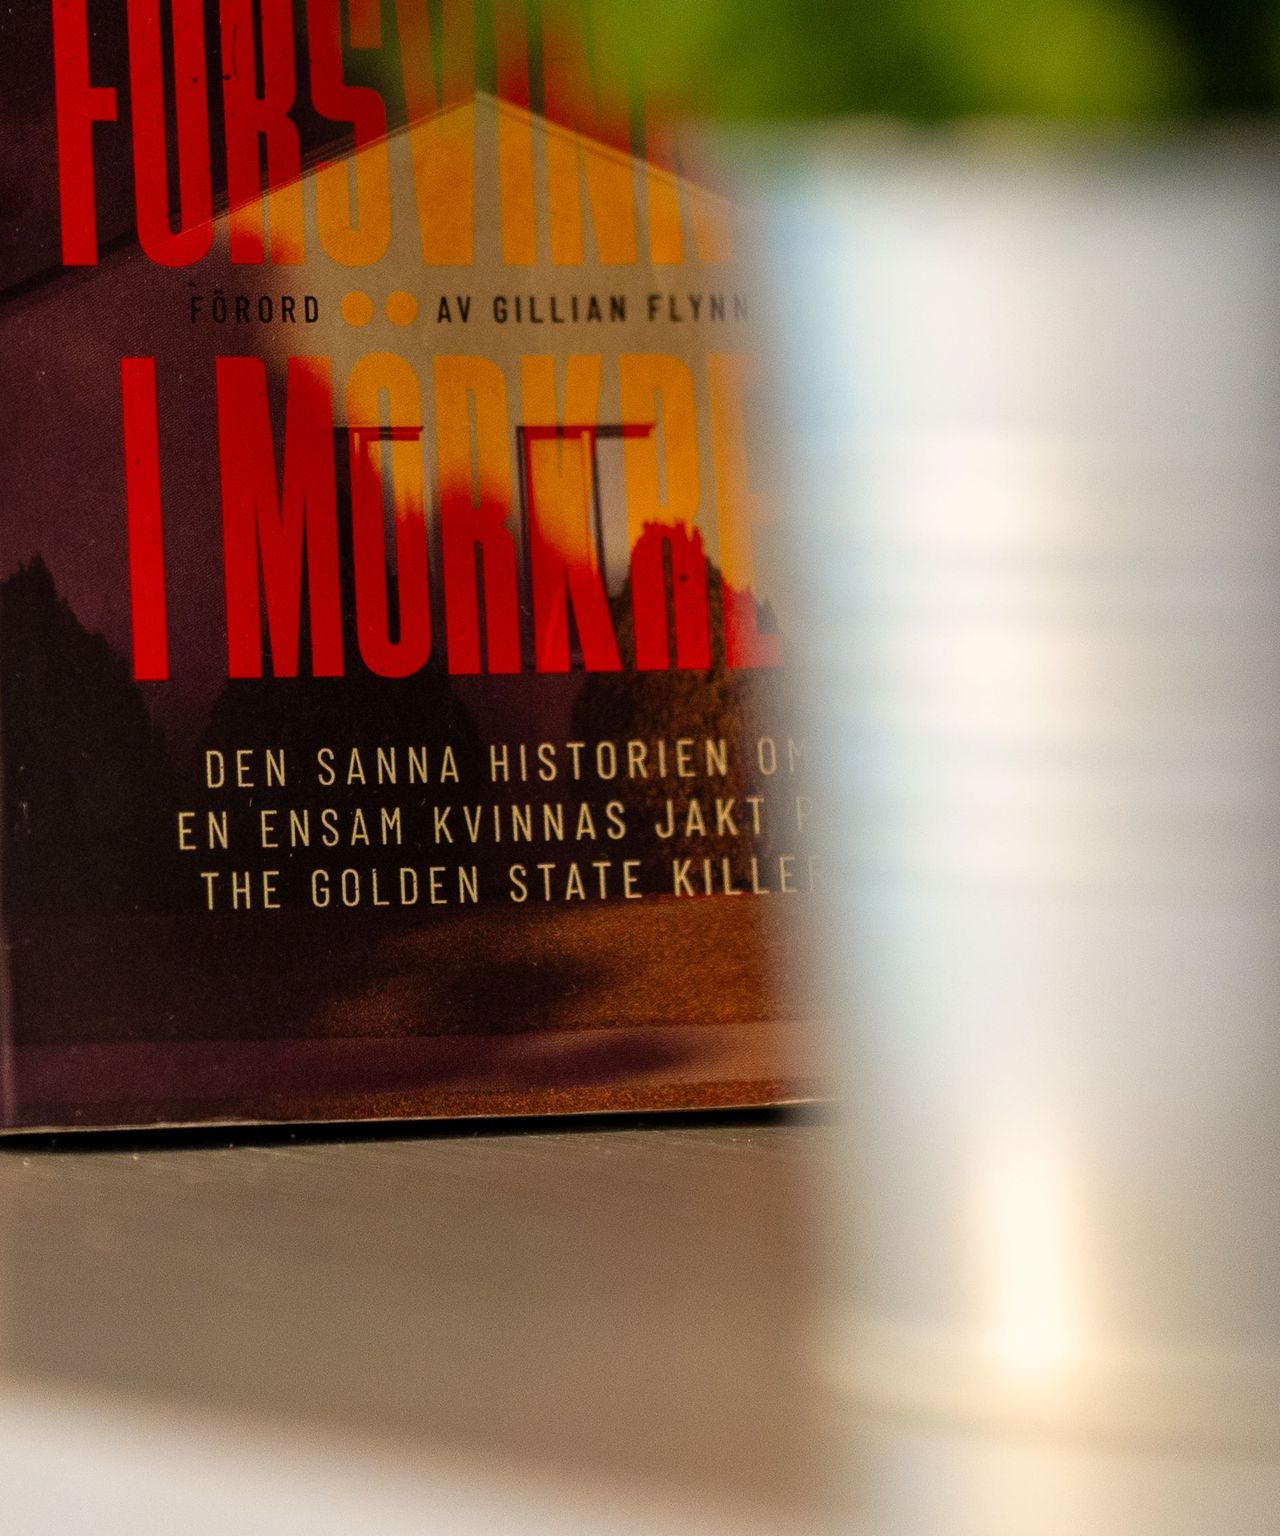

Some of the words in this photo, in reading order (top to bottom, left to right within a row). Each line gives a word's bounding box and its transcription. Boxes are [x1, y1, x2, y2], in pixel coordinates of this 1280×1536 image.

[190, 282, 320, 324] FÖRORD
[436, 294, 472, 324] AV
[492, 293, 628, 325] GILLIAN
[647, 292, 751, 324] FLYNN
[120, 356, 170, 681] I
[215, 290, 786, 679] MÖRKRE
[205, 748, 287, 789] DEN
[317, 744, 460, 786] SANNA
[490, 737, 729, 784] HISTORIEN
[179, 810, 229, 851] EN
[261, 806, 404, 849] ENSAM
[433, 800, 627, 846] KVINNAS
[654, 794, 765, 840] JAKT
[200, 870, 282, 911] THE
[311, 865, 480, 908] GOLDEN
[509, 859, 644, 904] STATE
